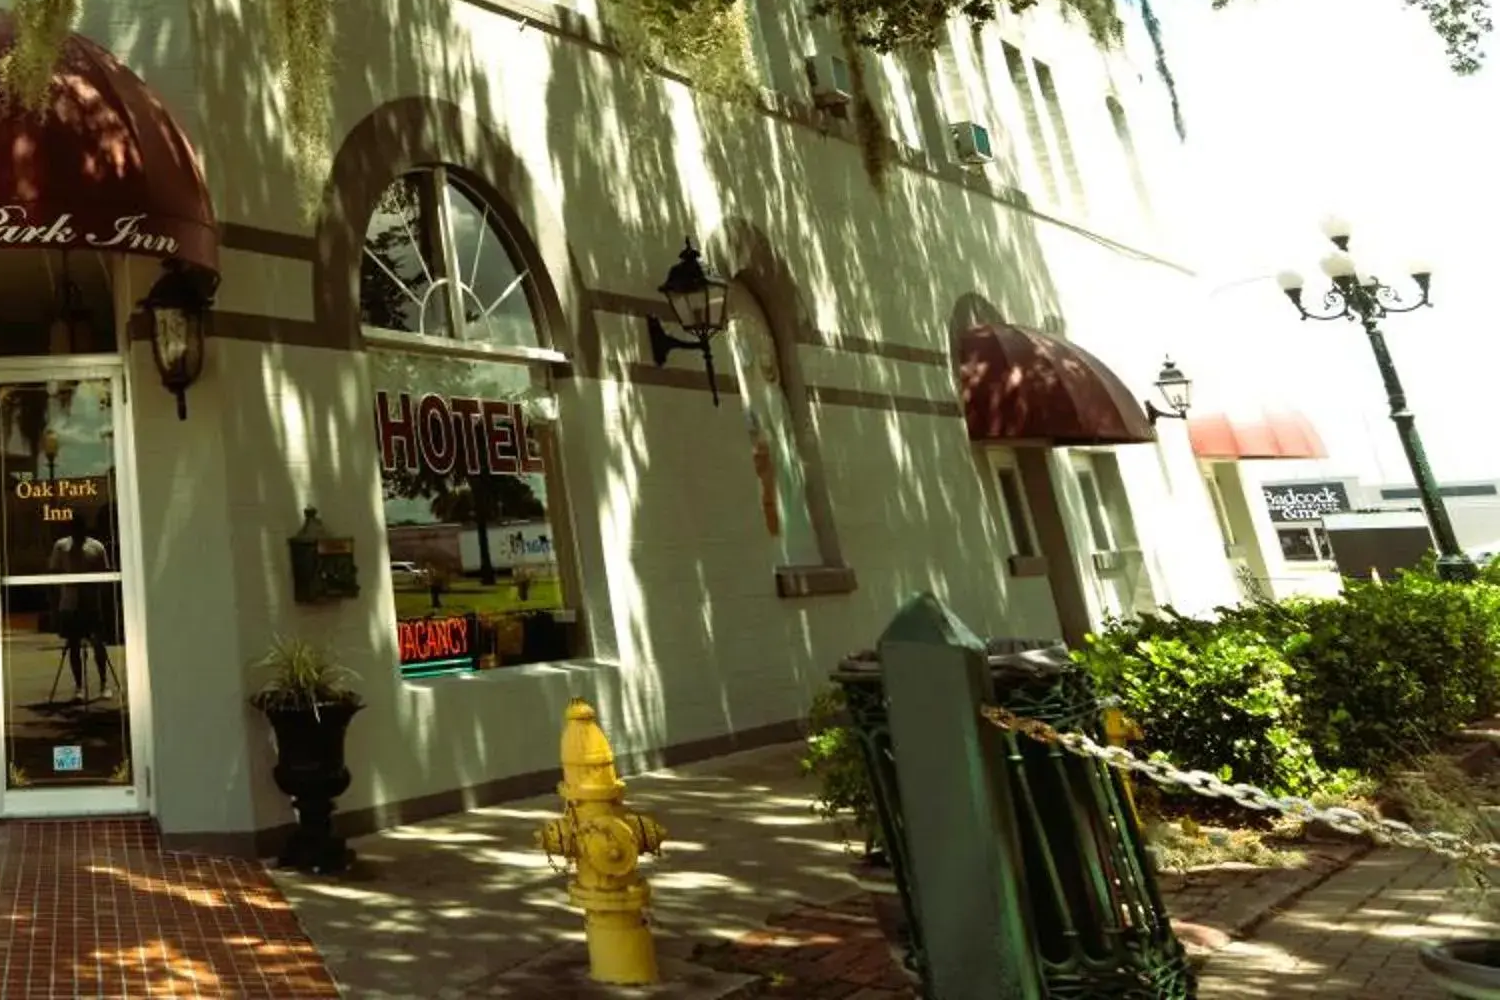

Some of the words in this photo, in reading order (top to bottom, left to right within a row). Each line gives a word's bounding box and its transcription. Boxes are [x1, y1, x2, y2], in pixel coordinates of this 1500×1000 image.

[85, 213, 179, 254] Inn
[376, 390, 545, 475] HOTEL
[16, 478, 53, 499] Oak
[58, 480, 98, 497] Park
[43, 503, 73, 521] Inn
